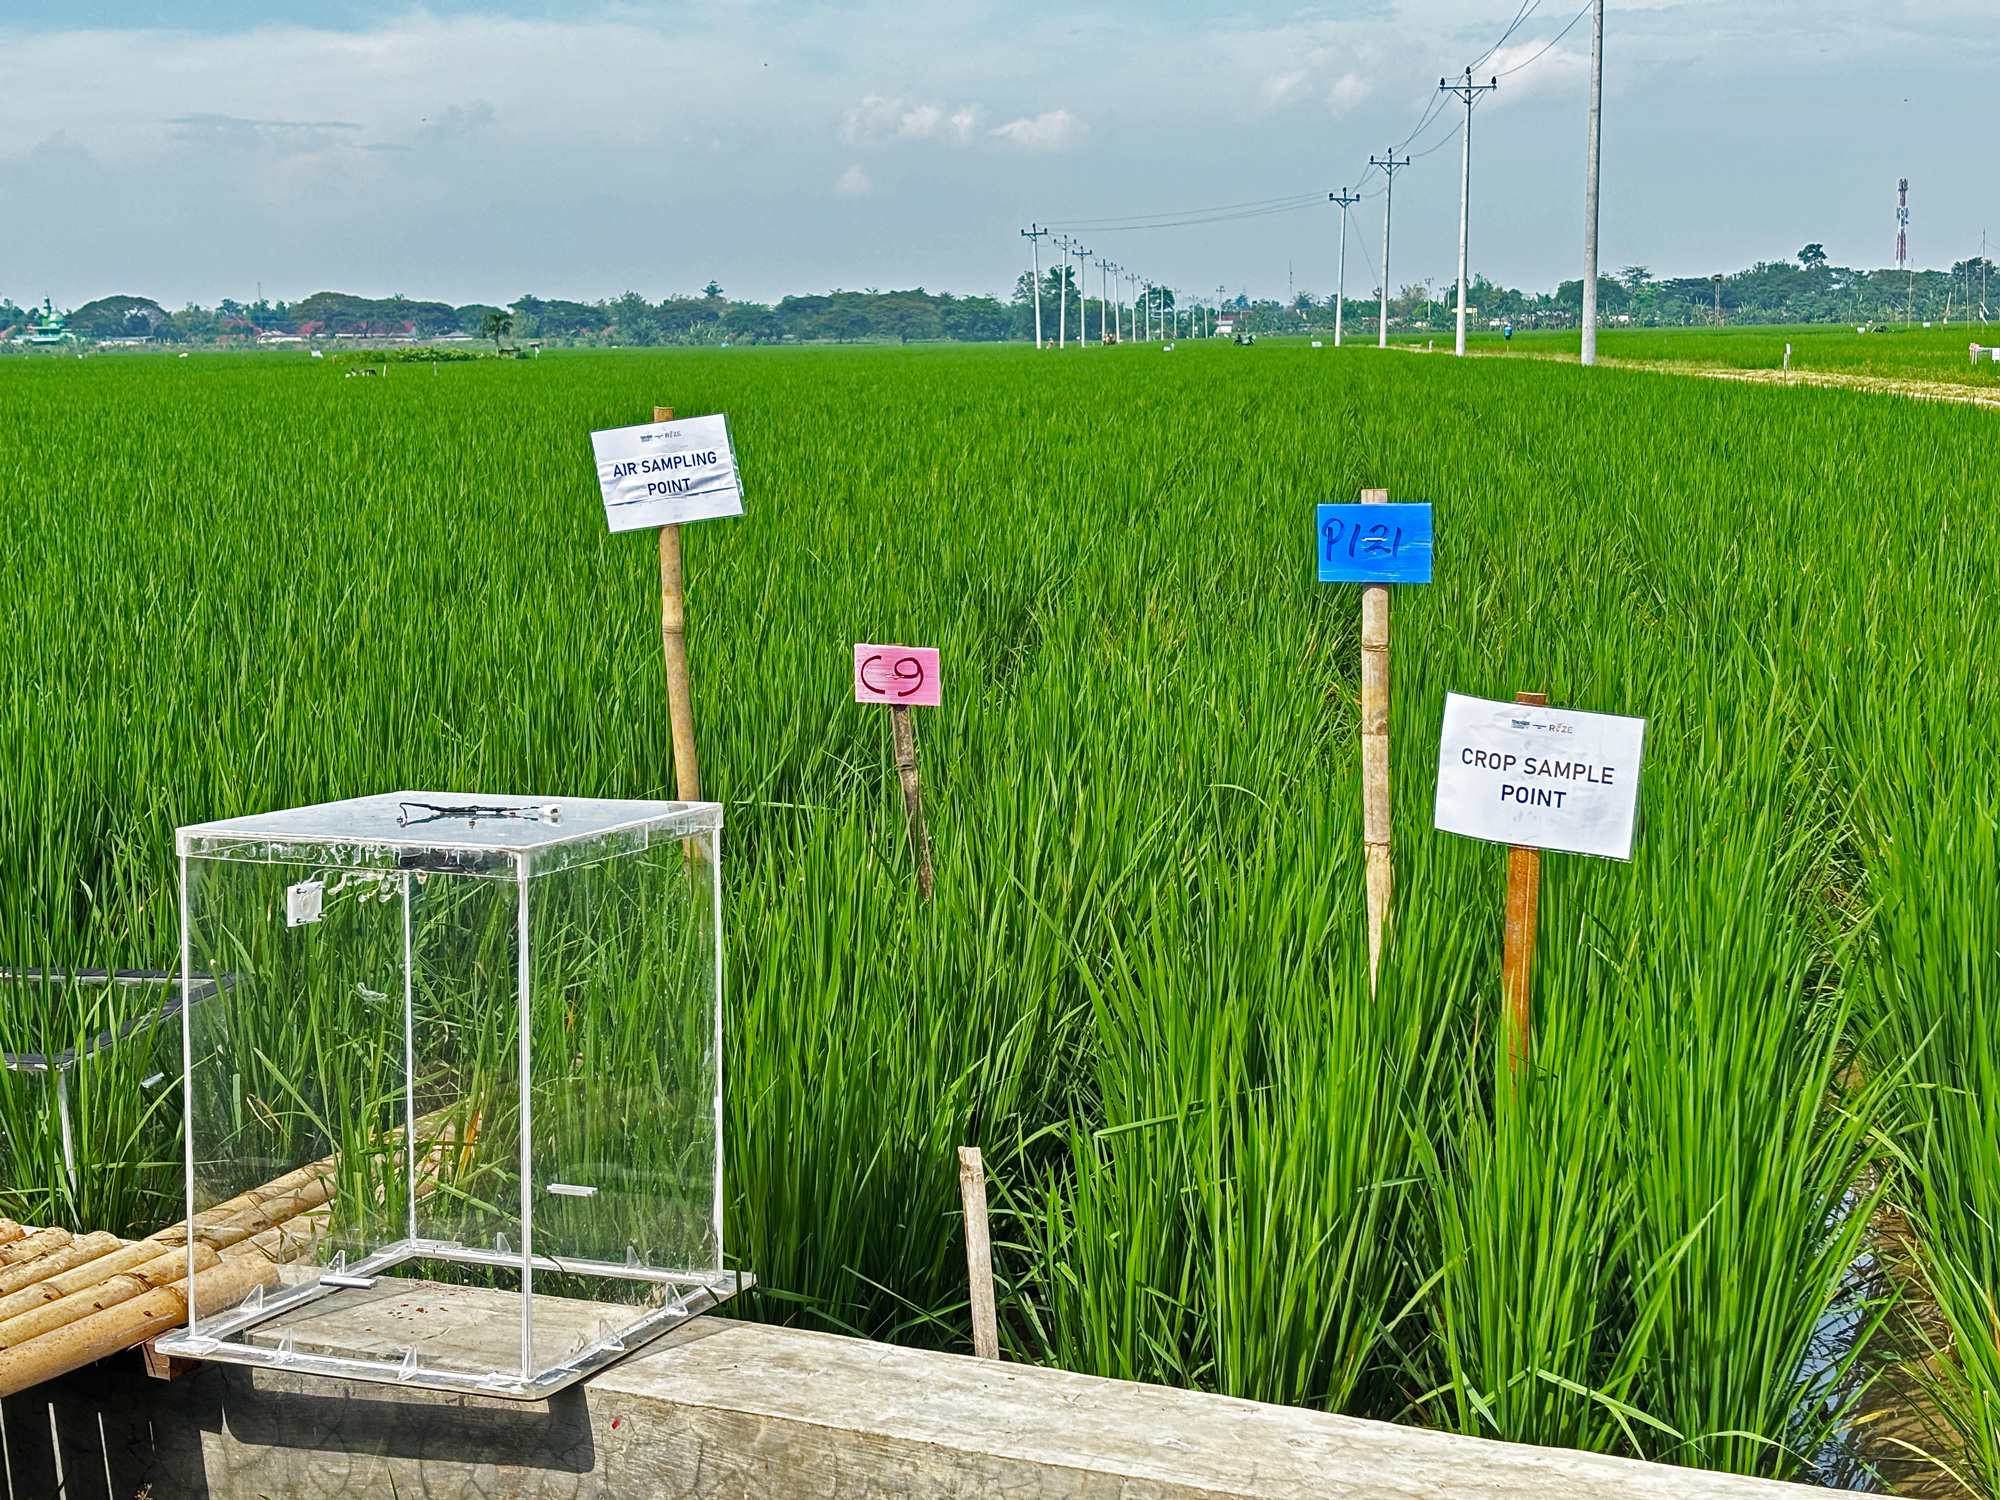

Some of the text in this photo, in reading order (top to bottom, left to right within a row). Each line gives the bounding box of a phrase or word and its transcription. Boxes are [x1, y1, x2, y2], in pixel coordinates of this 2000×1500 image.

[613, 451, 717, 478] AIR SAMPLING
[647, 478, 691, 496] POINT
[1321, 517, 1402, 562] P121
[861, 655, 924, 697] C9
[1461, 747, 1614, 785] CROP SAMPLE
[1501, 784, 1566, 808] POINT
